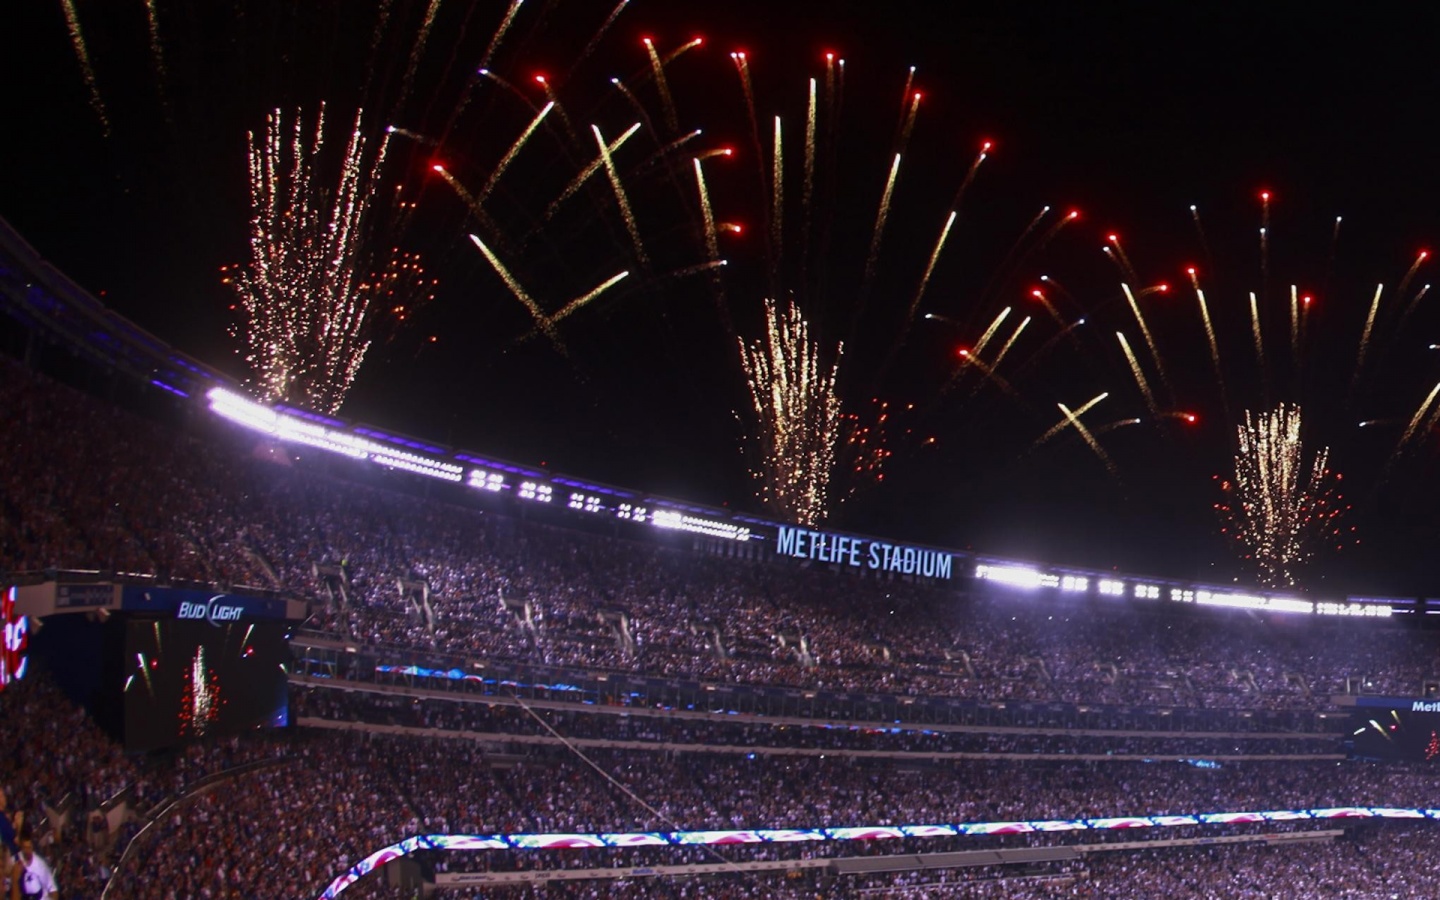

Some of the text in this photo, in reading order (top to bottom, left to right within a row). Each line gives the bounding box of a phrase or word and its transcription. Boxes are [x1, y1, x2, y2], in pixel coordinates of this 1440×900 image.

[776, 527, 952, 580] METLIFE STADIUM
[177, 601, 244, 622] BUD LIGHT
